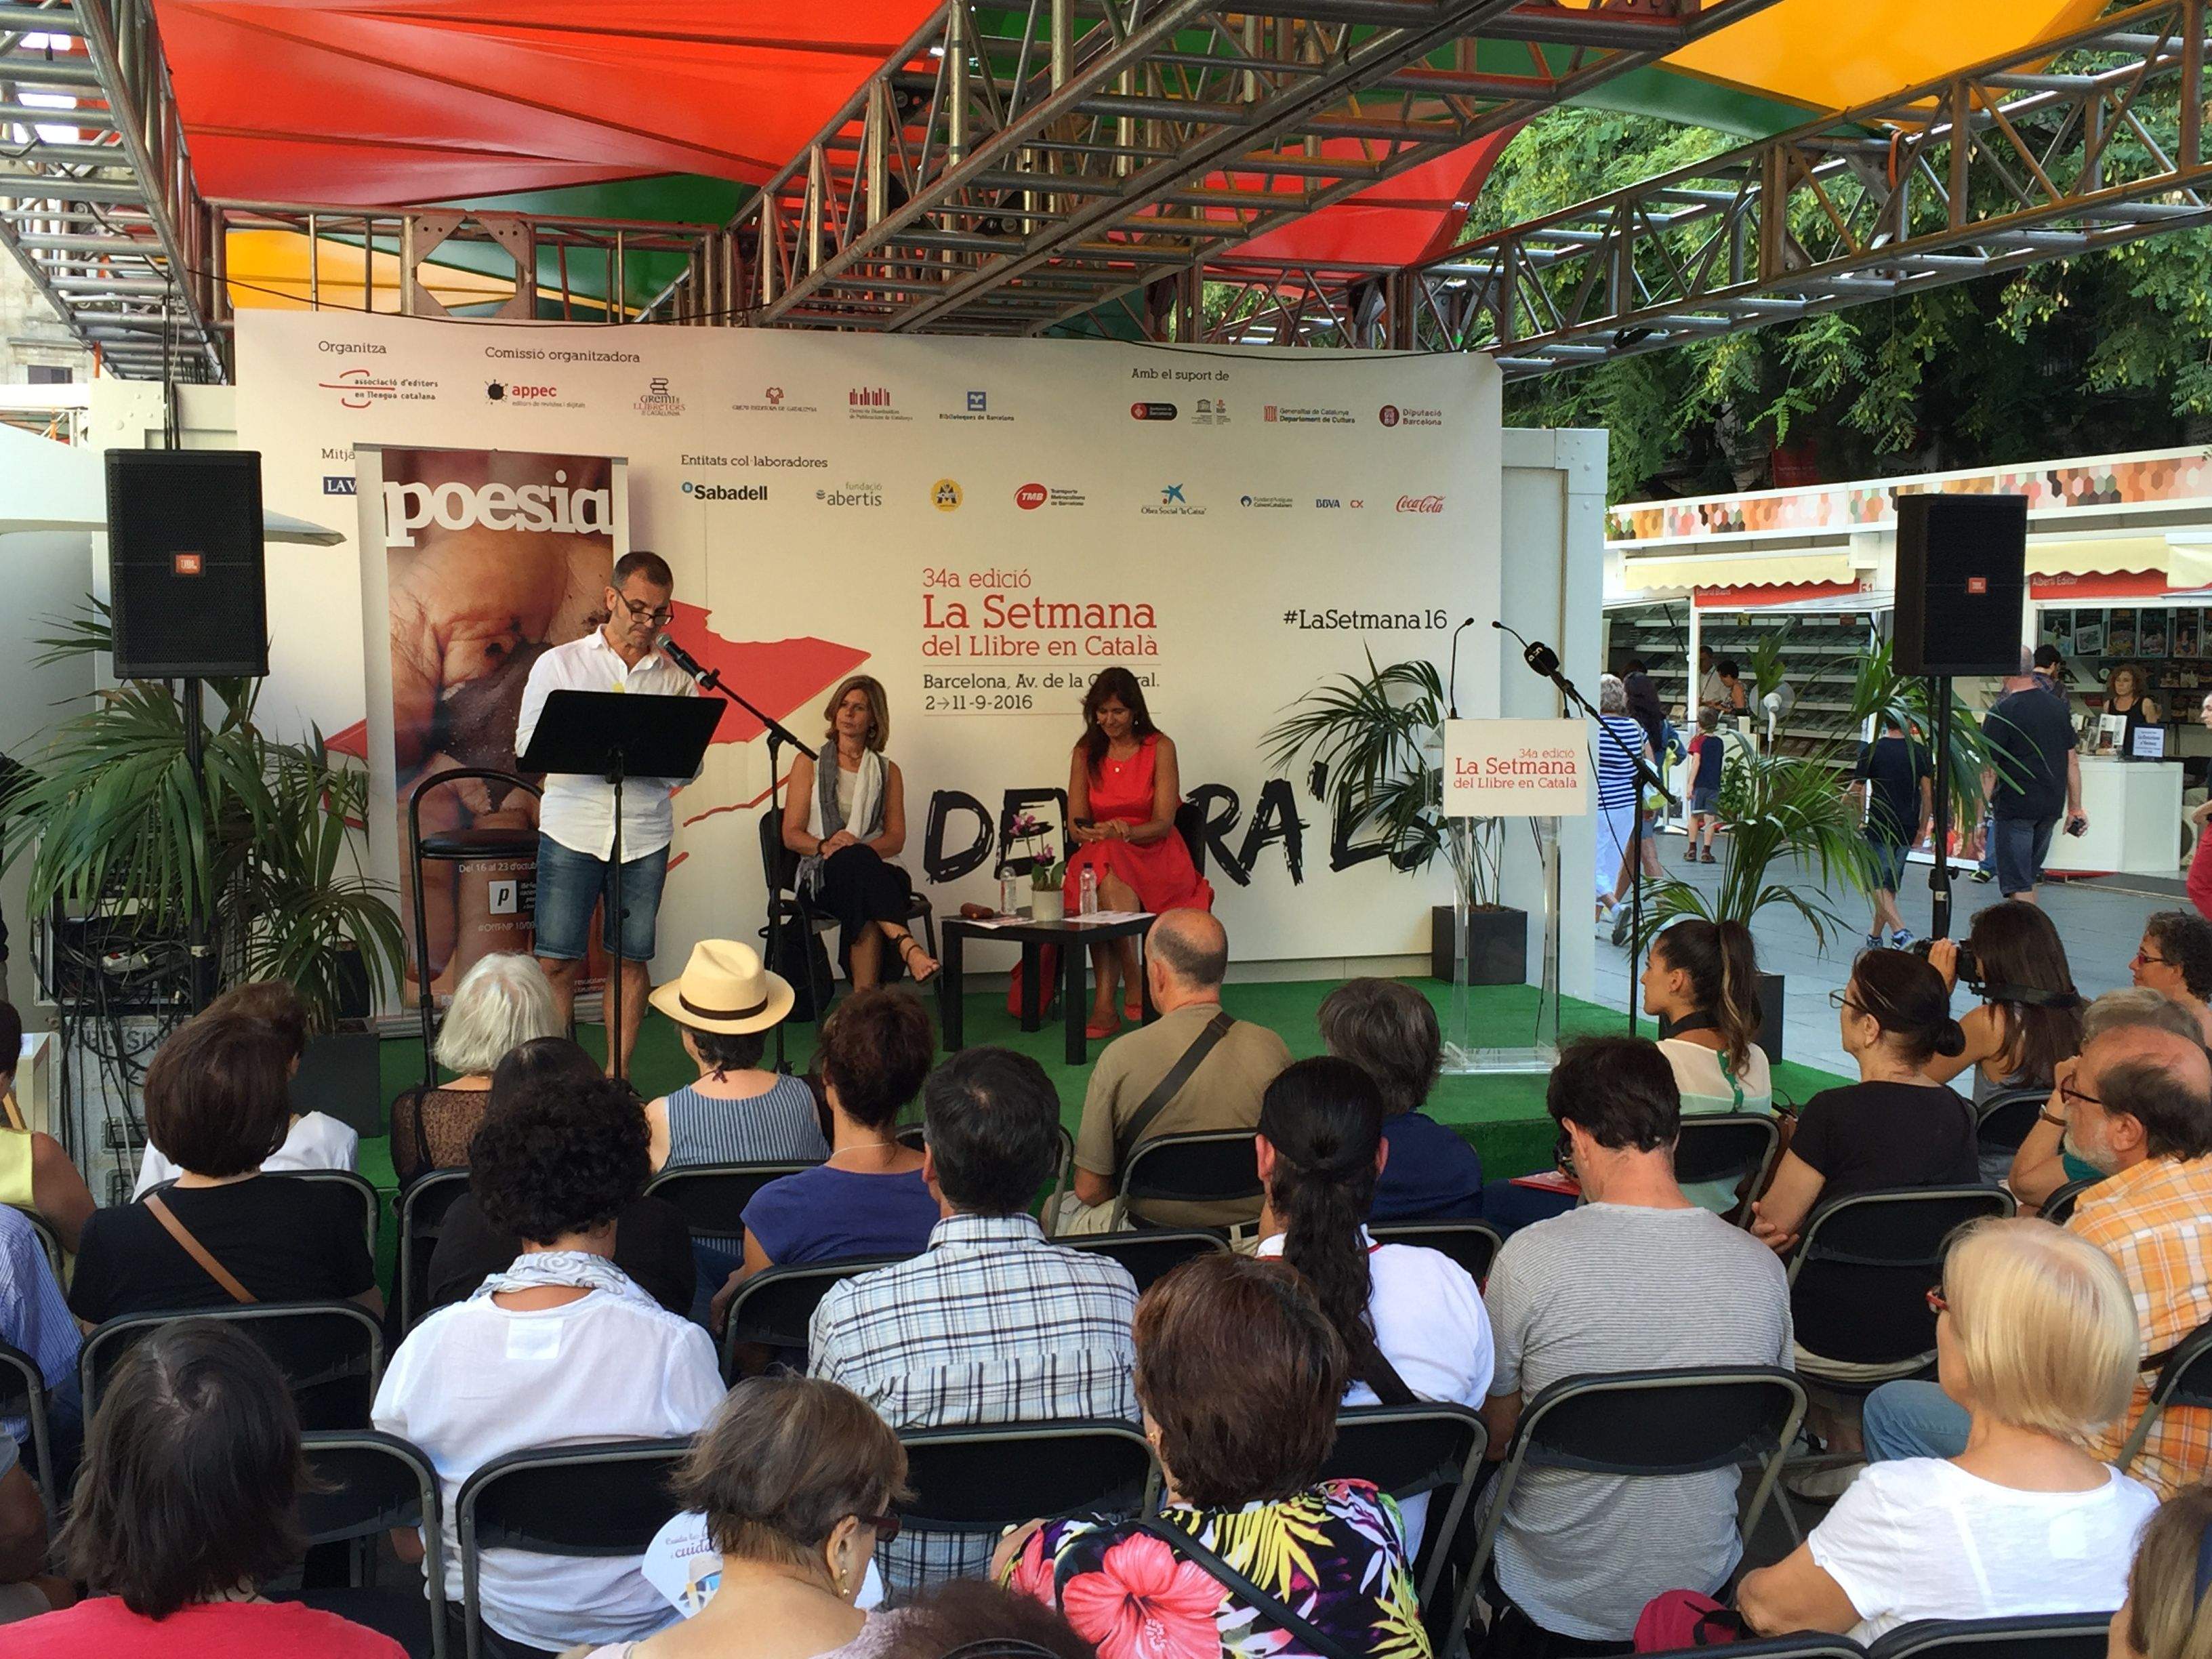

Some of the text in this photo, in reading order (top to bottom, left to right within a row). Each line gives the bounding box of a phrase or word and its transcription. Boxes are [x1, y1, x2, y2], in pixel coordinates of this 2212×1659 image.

[319, 341, 386, 354] Organitza
[485, 346, 640, 363] Comissió organitzadora
[1131, 369, 1229, 382] Amb el suport de
[512, 385, 557, 398] appec
[1403, 408, 1442, 417] Diputació
[1403, 418, 1442, 426] Barcelona
[322, 448, 355, 462] Mitja
[681, 455, 727, 466] Entitats
[694, 485, 768, 500] Sabadell
[827, 491, 882, 506] abertis
[1021, 493, 1044, 501] TMB
[383, 470, 613, 547] poesia
[1315, 499, 1340, 508] BBVA
[922, 568, 1031, 588] 34a edició
[922, 594, 1157, 629] La Setmana
[922, 634, 1159, 657] del Llibre en Català
[924, 673, 1011, 690] Barcelona,
[1015, 674, 1038, 689] Av.
[1043, 673, 1064, 689] de
[1069, 673, 1083, 688] la
[1519, 748, 1538, 759] 34a
[1455, 757, 1577, 775] La Setmana
[1453, 777, 1474, 788] del
[1477, 777, 1515, 788] Llibre
[1518, 779, 1534, 788] en
[498, 862, 508, 871] 23
